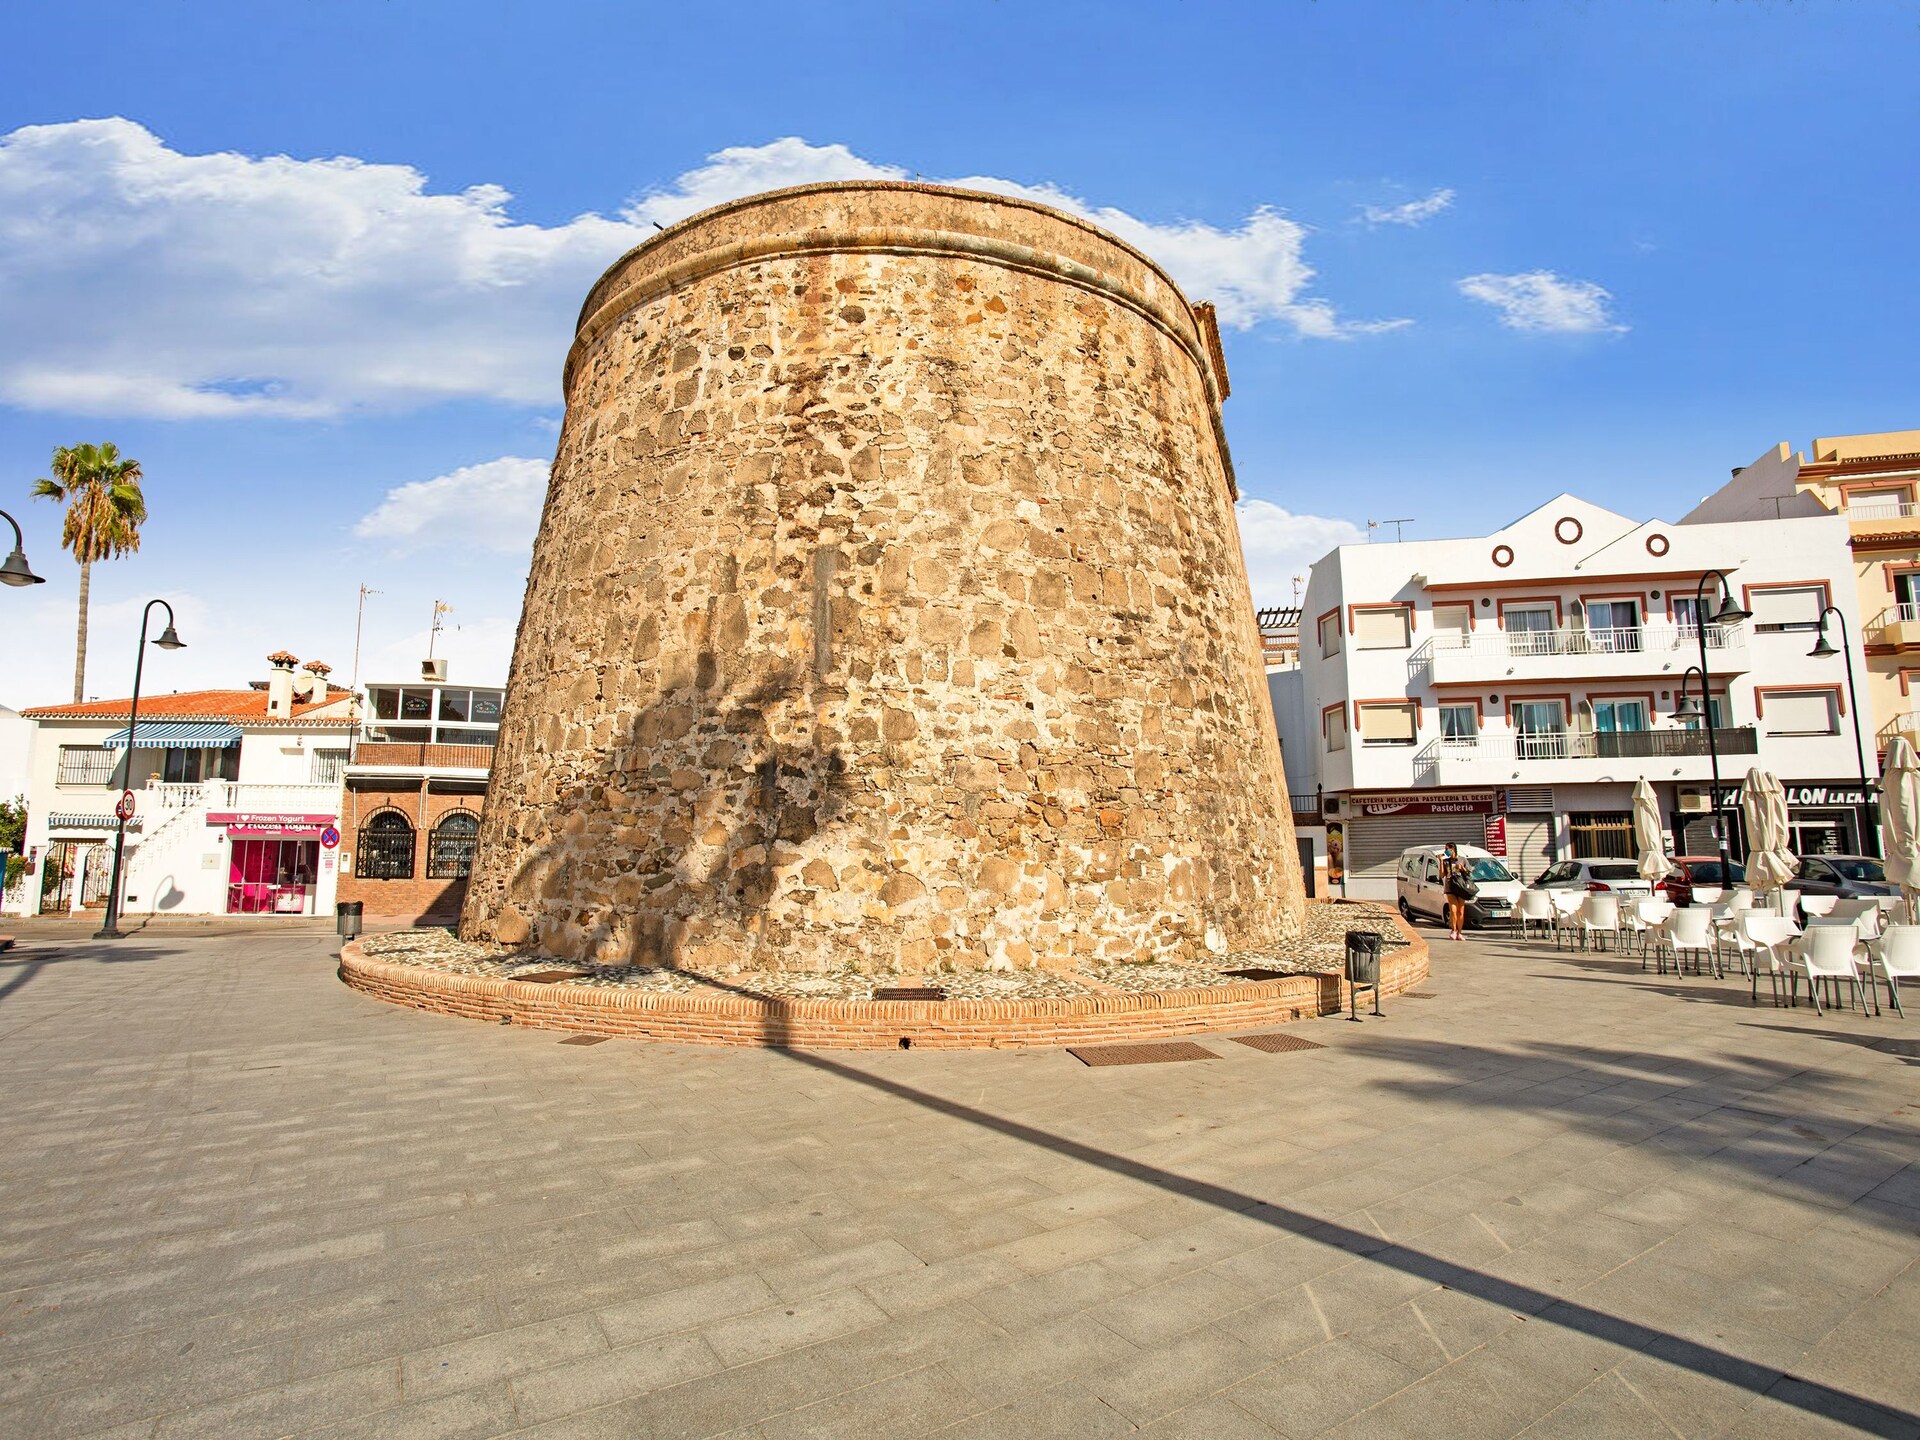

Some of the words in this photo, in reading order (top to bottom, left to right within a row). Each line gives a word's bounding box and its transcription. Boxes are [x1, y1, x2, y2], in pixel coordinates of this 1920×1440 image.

[1351, 796, 1384, 804] CAFETERIA
[1386, 795, 1419, 803] HELADERIA
[1828, 792, 1845, 803] LA
[125, 799, 132, 810] 30
[250, 814, 277, 822] Frozen
[278, 814, 305, 823] Yogurt
